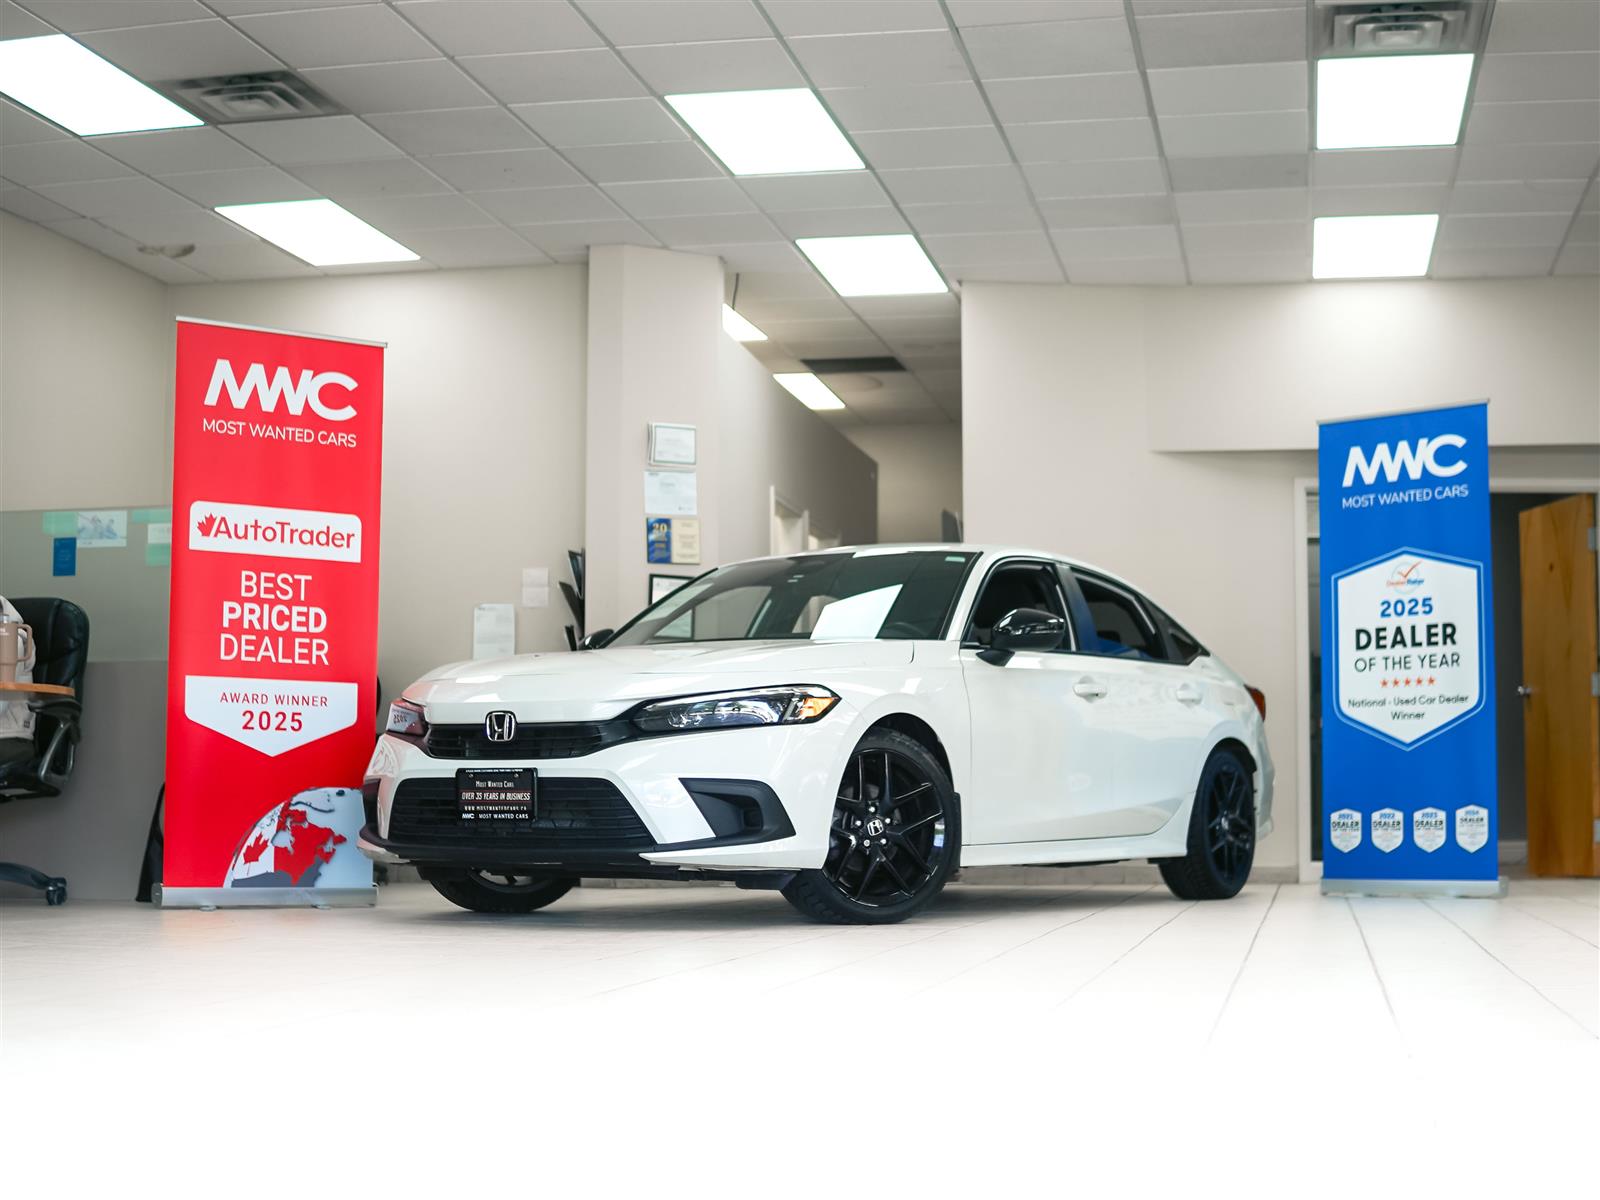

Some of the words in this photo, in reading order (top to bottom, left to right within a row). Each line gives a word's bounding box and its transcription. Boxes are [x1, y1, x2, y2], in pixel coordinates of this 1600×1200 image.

[204, 358, 358, 421] MWC
[203, 418, 245, 436] MOST
[249, 422, 314, 443] WANTED
[318, 431, 356, 447] CARS
[1342, 434, 1468, 488] MWC
[1342, 493, 1376, 509] MOST
[1378, 488, 1432, 505] WANTED
[1434, 484, 1469, 500] CARS
[213, 516, 355, 549] AutoTrader
[240, 570, 312, 601] BEST
[222, 601, 327, 633] PRICED
[1380, 597, 1433, 618] 2025
[220, 633, 329, 665] DEALER
[1355, 622, 1457, 651] DEALER
[1354, 657, 1376, 672] OF
[1382, 655, 1412, 671] THE
[1418, 652, 1460, 669] YEAR
[220, 692, 269, 706] AWARD
[275, 694, 328, 707] WINNER
[1348, 697, 1386, 708] National
[1393, 695, 1416, 706] Used
[1418, 695, 1436, 705] Car
[1439, 694, 1468, 704] Dealer
[242, 710, 303, 732] 2025
[1391, 711, 1425, 720] Winner
[462, 792, 475, 800] OVER
[483, 792, 499, 800] YEARS
[500, 792, 505, 800] IN
[506, 792, 531, 800] BUSINESS
[1415, 820, 1443, 828] DEALER
